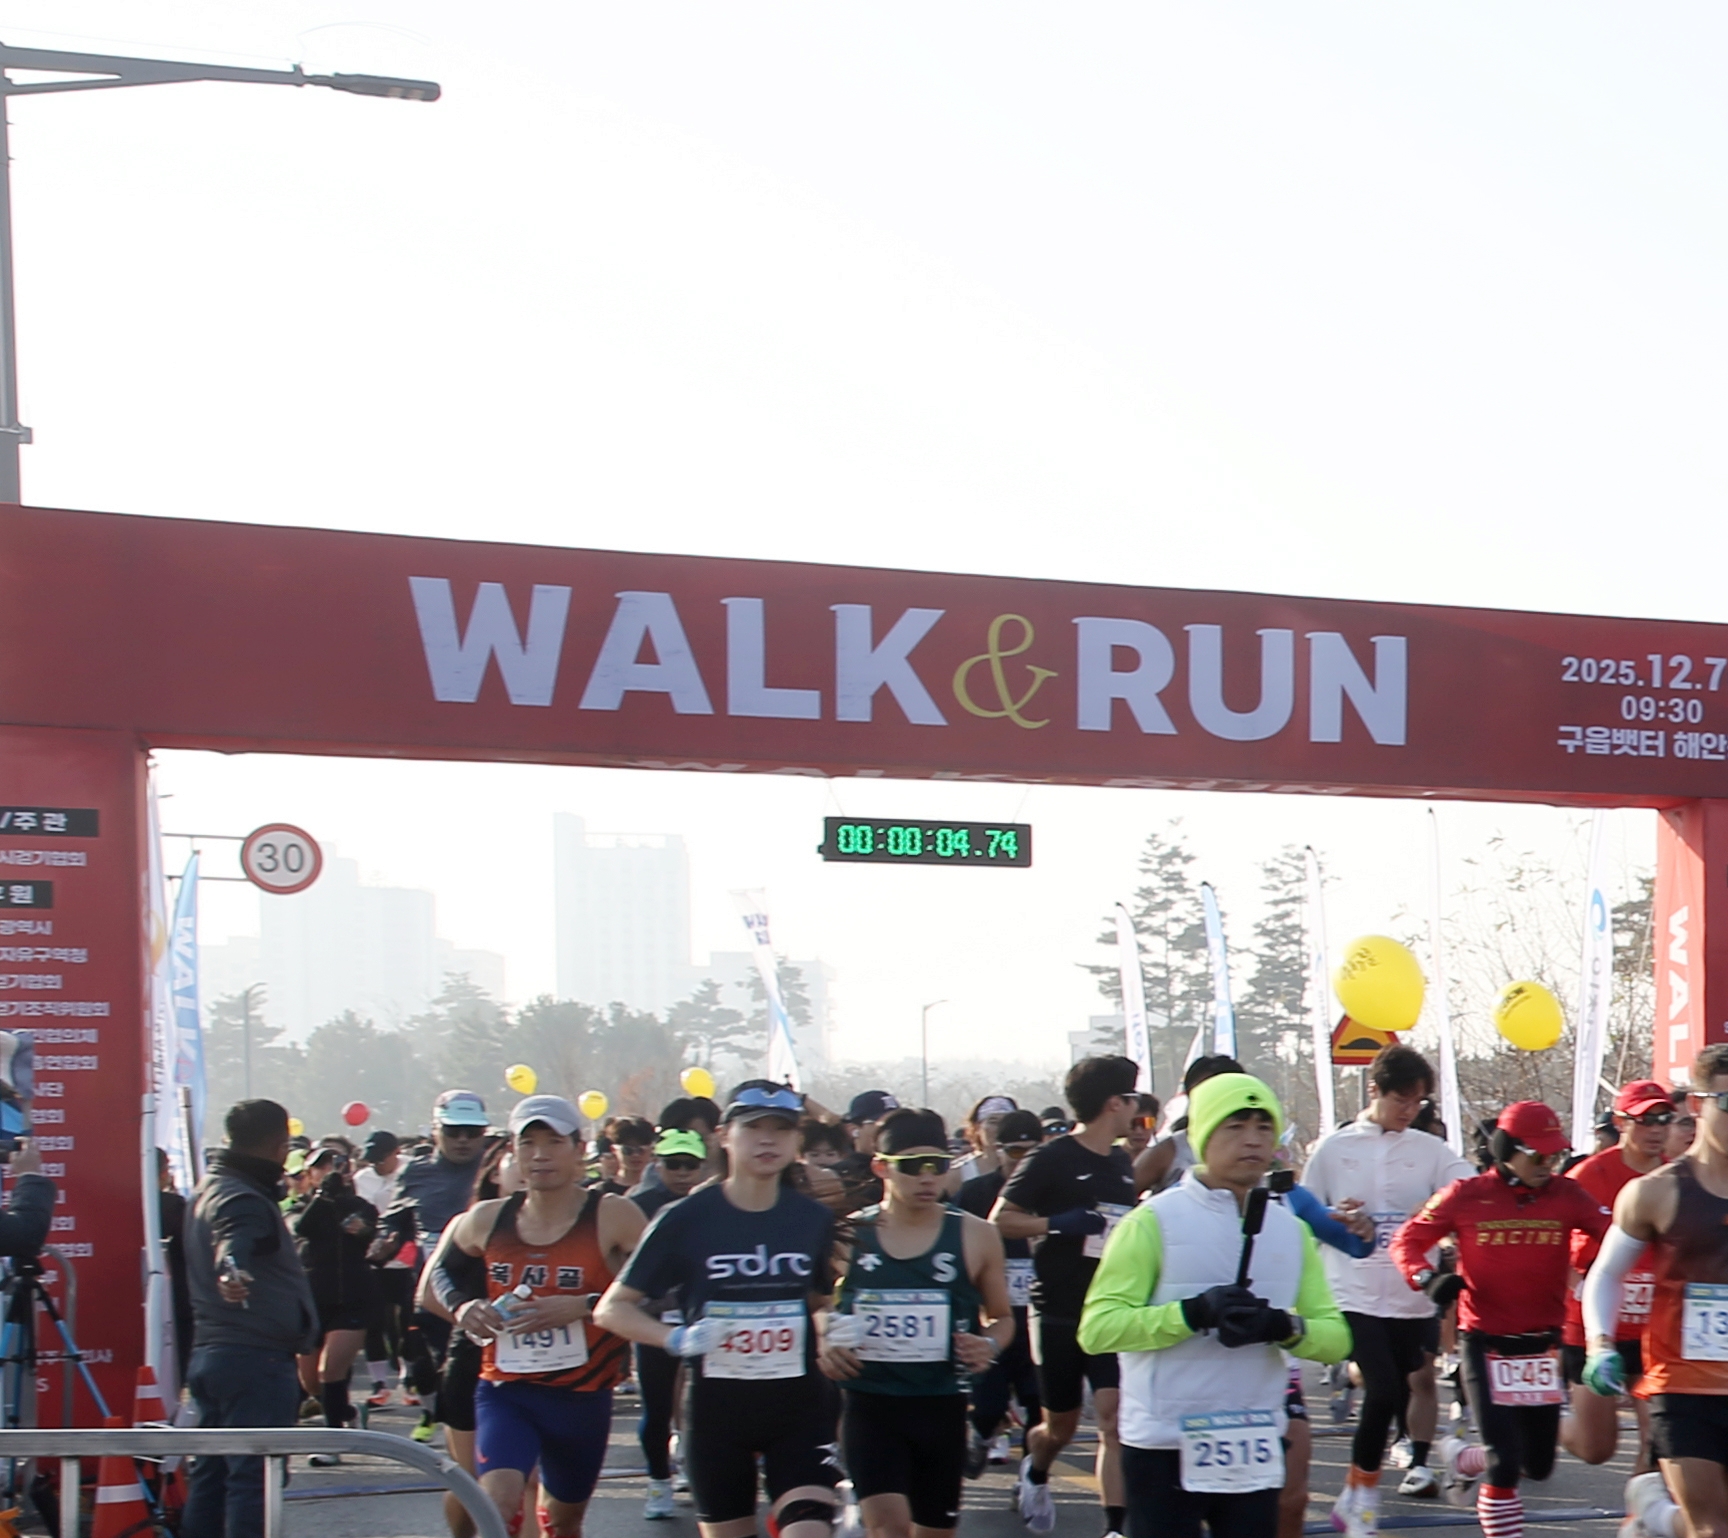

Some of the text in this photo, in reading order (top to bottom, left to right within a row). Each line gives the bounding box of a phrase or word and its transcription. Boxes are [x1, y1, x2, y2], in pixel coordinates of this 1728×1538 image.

[408, 576, 1407, 745] WALK & RUN
[1621, 695, 1704, 724] 09:30
[1557, 725, 1665, 758] 구읍뱃터
[837, 824, 1019, 859] 00:00:04.74
[256, 842, 305, 874] 30
[705, 1243, 812, 1280] sdrc
[932, 1251, 958, 1283] S
[864, 1314, 936, 1338] 2581
[1193, 1438, 1273, 1468] 2515
